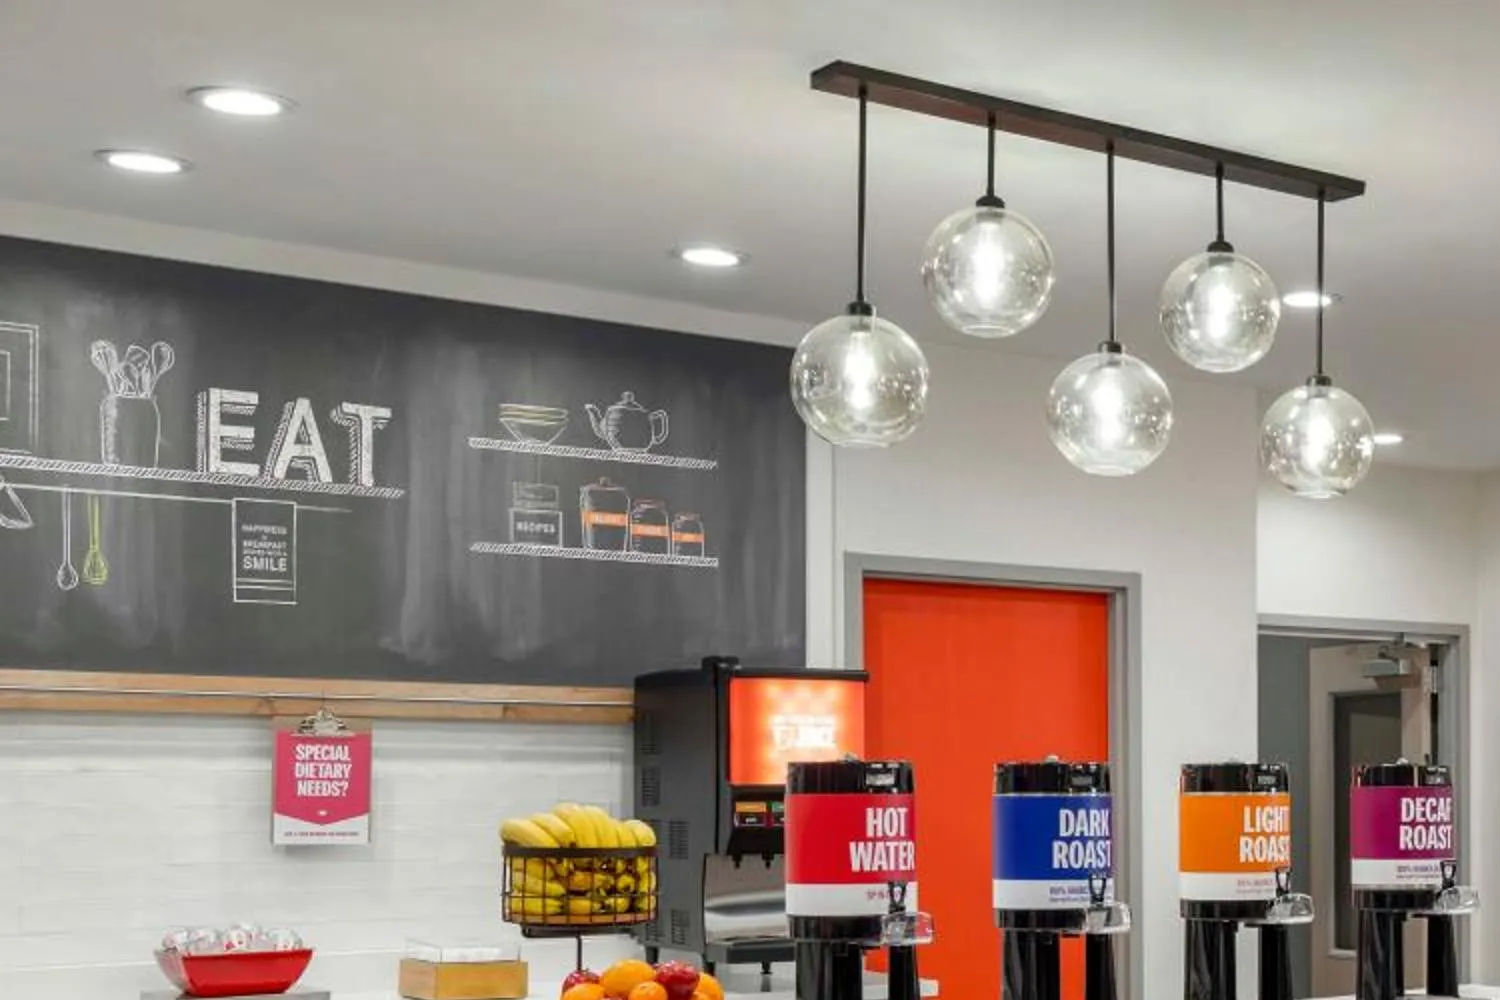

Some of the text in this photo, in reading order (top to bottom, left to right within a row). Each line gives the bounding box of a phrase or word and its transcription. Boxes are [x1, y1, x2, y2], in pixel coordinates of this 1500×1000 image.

[198, 387, 392, 487] EAT
[243, 555, 287, 571] SMILE
[295, 743, 351, 761] SPECIAL
[294, 762, 352, 779] DIETARY
[297, 779, 349, 797] NEEDS?
[865, 807, 908, 837] HOT
[1059, 808, 1109, 837] DARK
[1399, 824, 1453, 850] ROAST
[849, 841, 915, 871] WATER
[1052, 840, 1111, 869] ROAST
